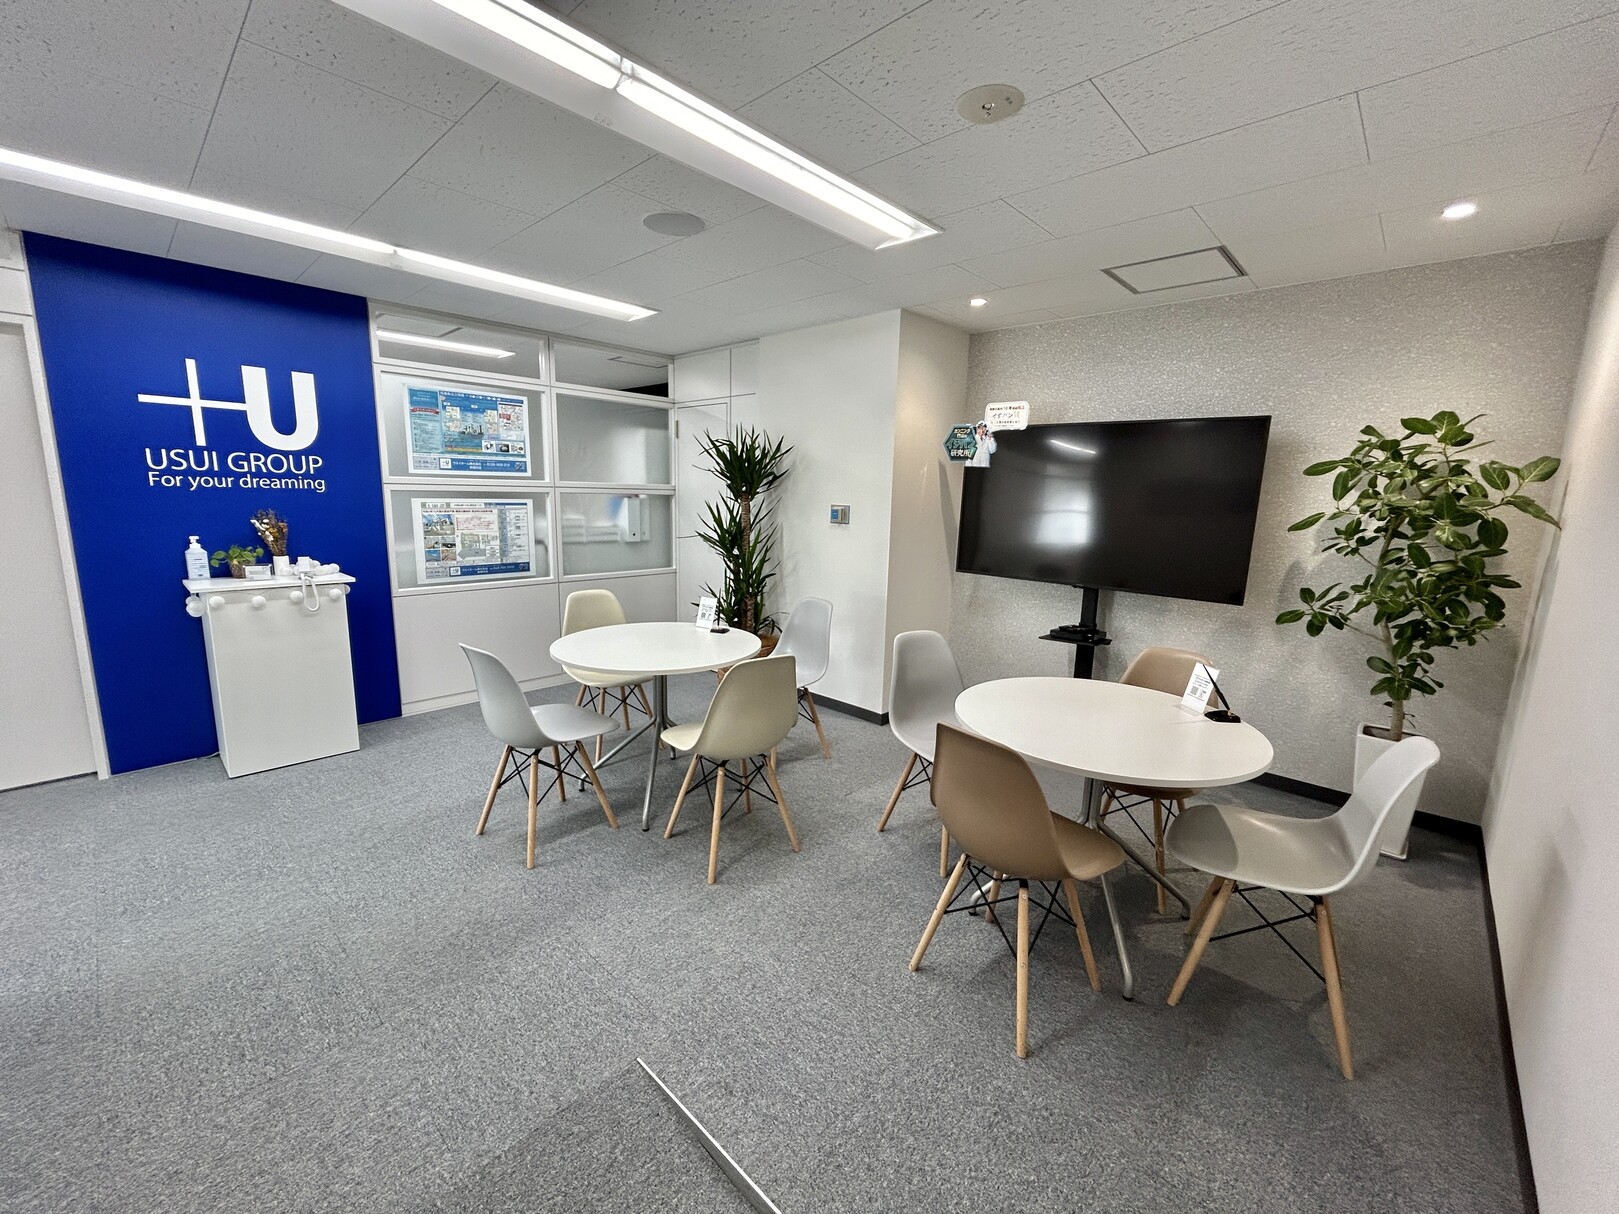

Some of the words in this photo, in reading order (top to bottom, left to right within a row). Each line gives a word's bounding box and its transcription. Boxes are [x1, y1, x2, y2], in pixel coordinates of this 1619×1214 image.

[145, 447, 219, 471] USUI
[227, 451, 323, 474] GROUP
[148, 471, 184, 487] For
[187, 476, 235, 491] your
[239, 473, 326, 493] dreaming
